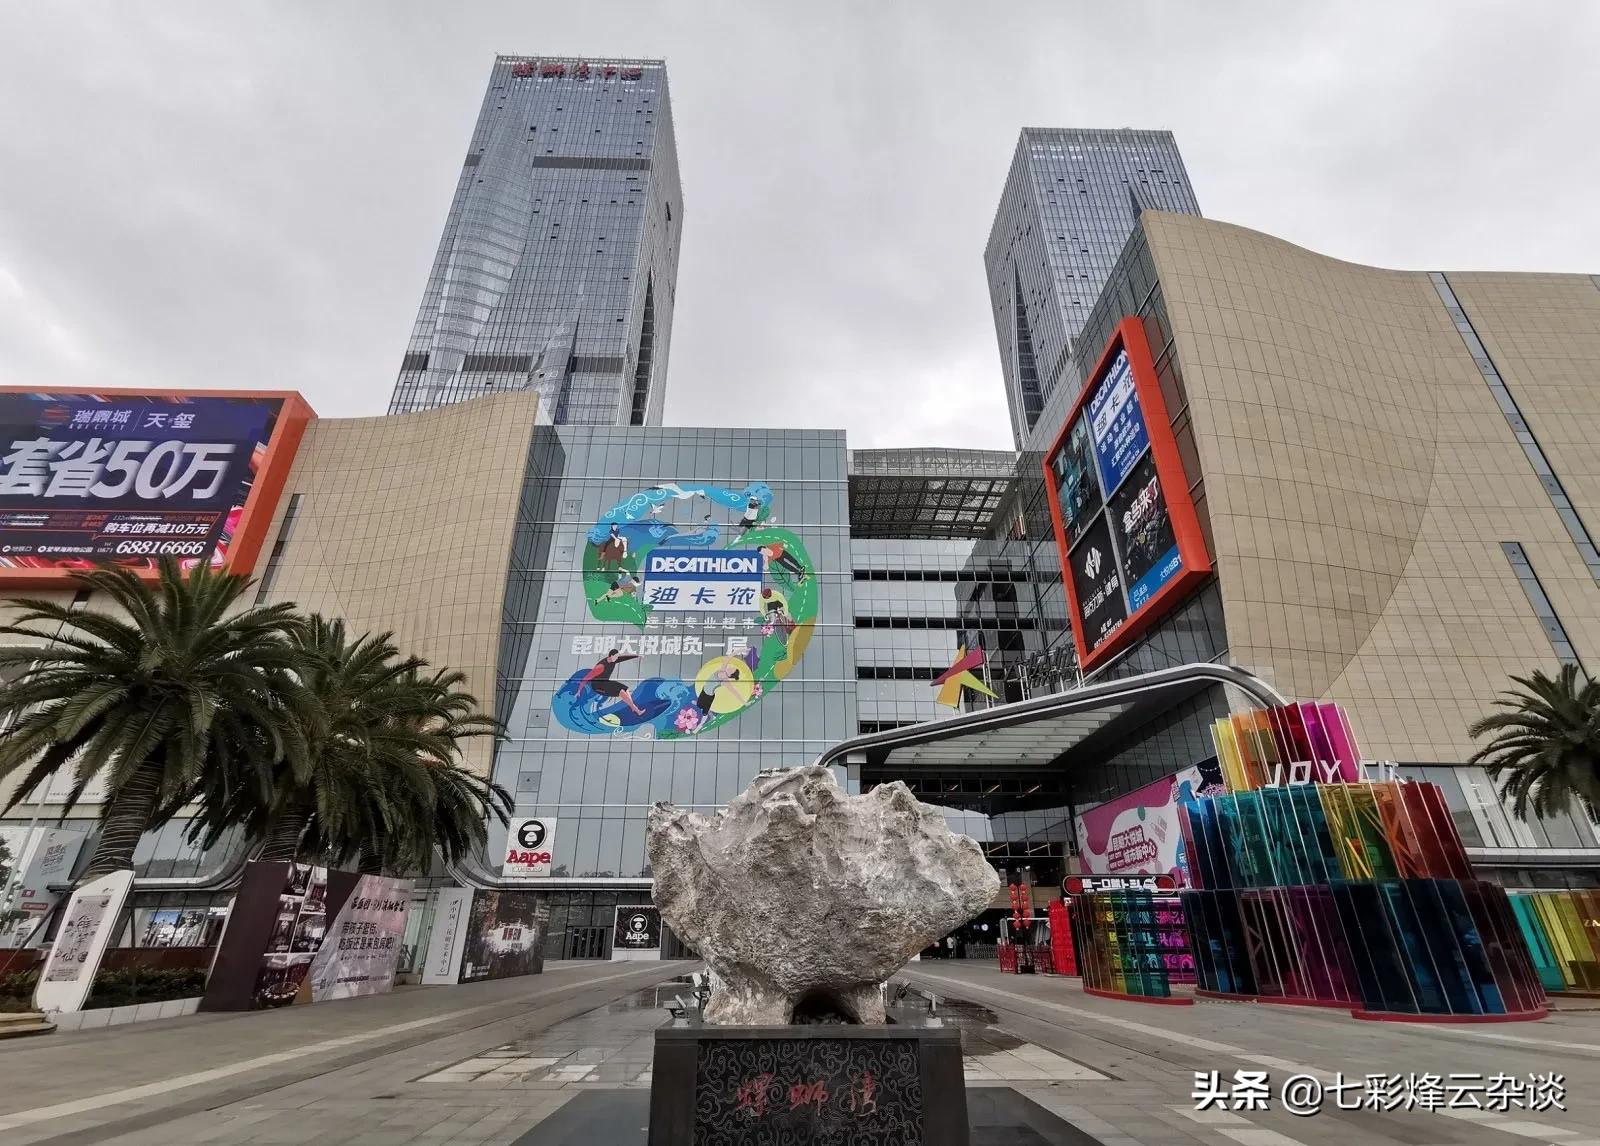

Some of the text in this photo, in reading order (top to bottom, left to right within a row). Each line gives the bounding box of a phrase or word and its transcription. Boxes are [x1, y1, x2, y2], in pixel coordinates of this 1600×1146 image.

[102, 523, 210, 535] 购车位再减10万元
[116, 540, 207, 555] 68816666
[651, 557, 758, 574] DECATHLON
[648, 586, 755, 605] 迪卡侬
[644, 616, 757, 630] 运动专业超市
[571, 635, 751, 656] 昆明大悦城负一层
[1265, 760, 1342, 788] JOY
[506, 850, 552, 867] Aape
[625, 932, 650, 942] Aape
